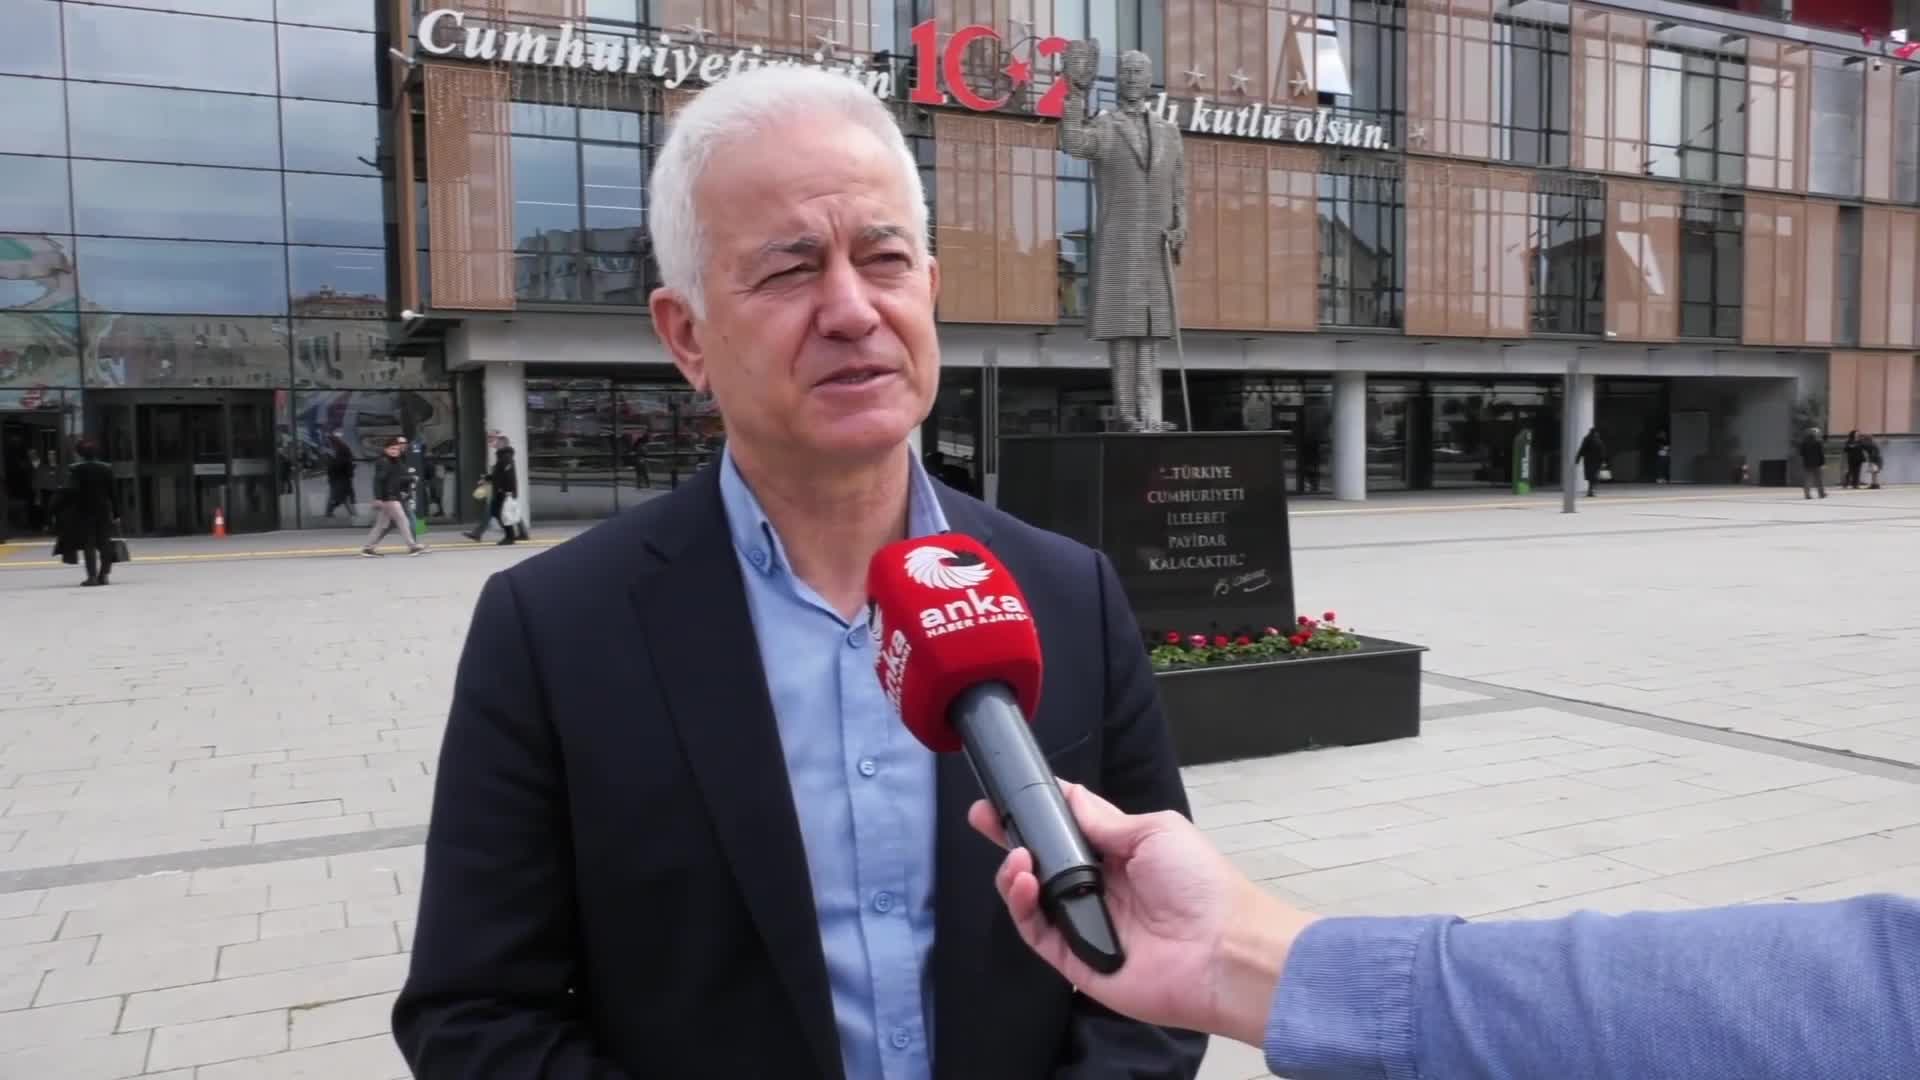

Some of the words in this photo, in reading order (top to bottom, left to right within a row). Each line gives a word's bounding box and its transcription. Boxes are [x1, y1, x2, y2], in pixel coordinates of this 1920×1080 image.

[1190, 97, 1283, 139] kutlu
[1295, 109, 1390, 150] olsun.
[919, 588, 1025, 629] anka
[925, 618, 975, 638] HABER
